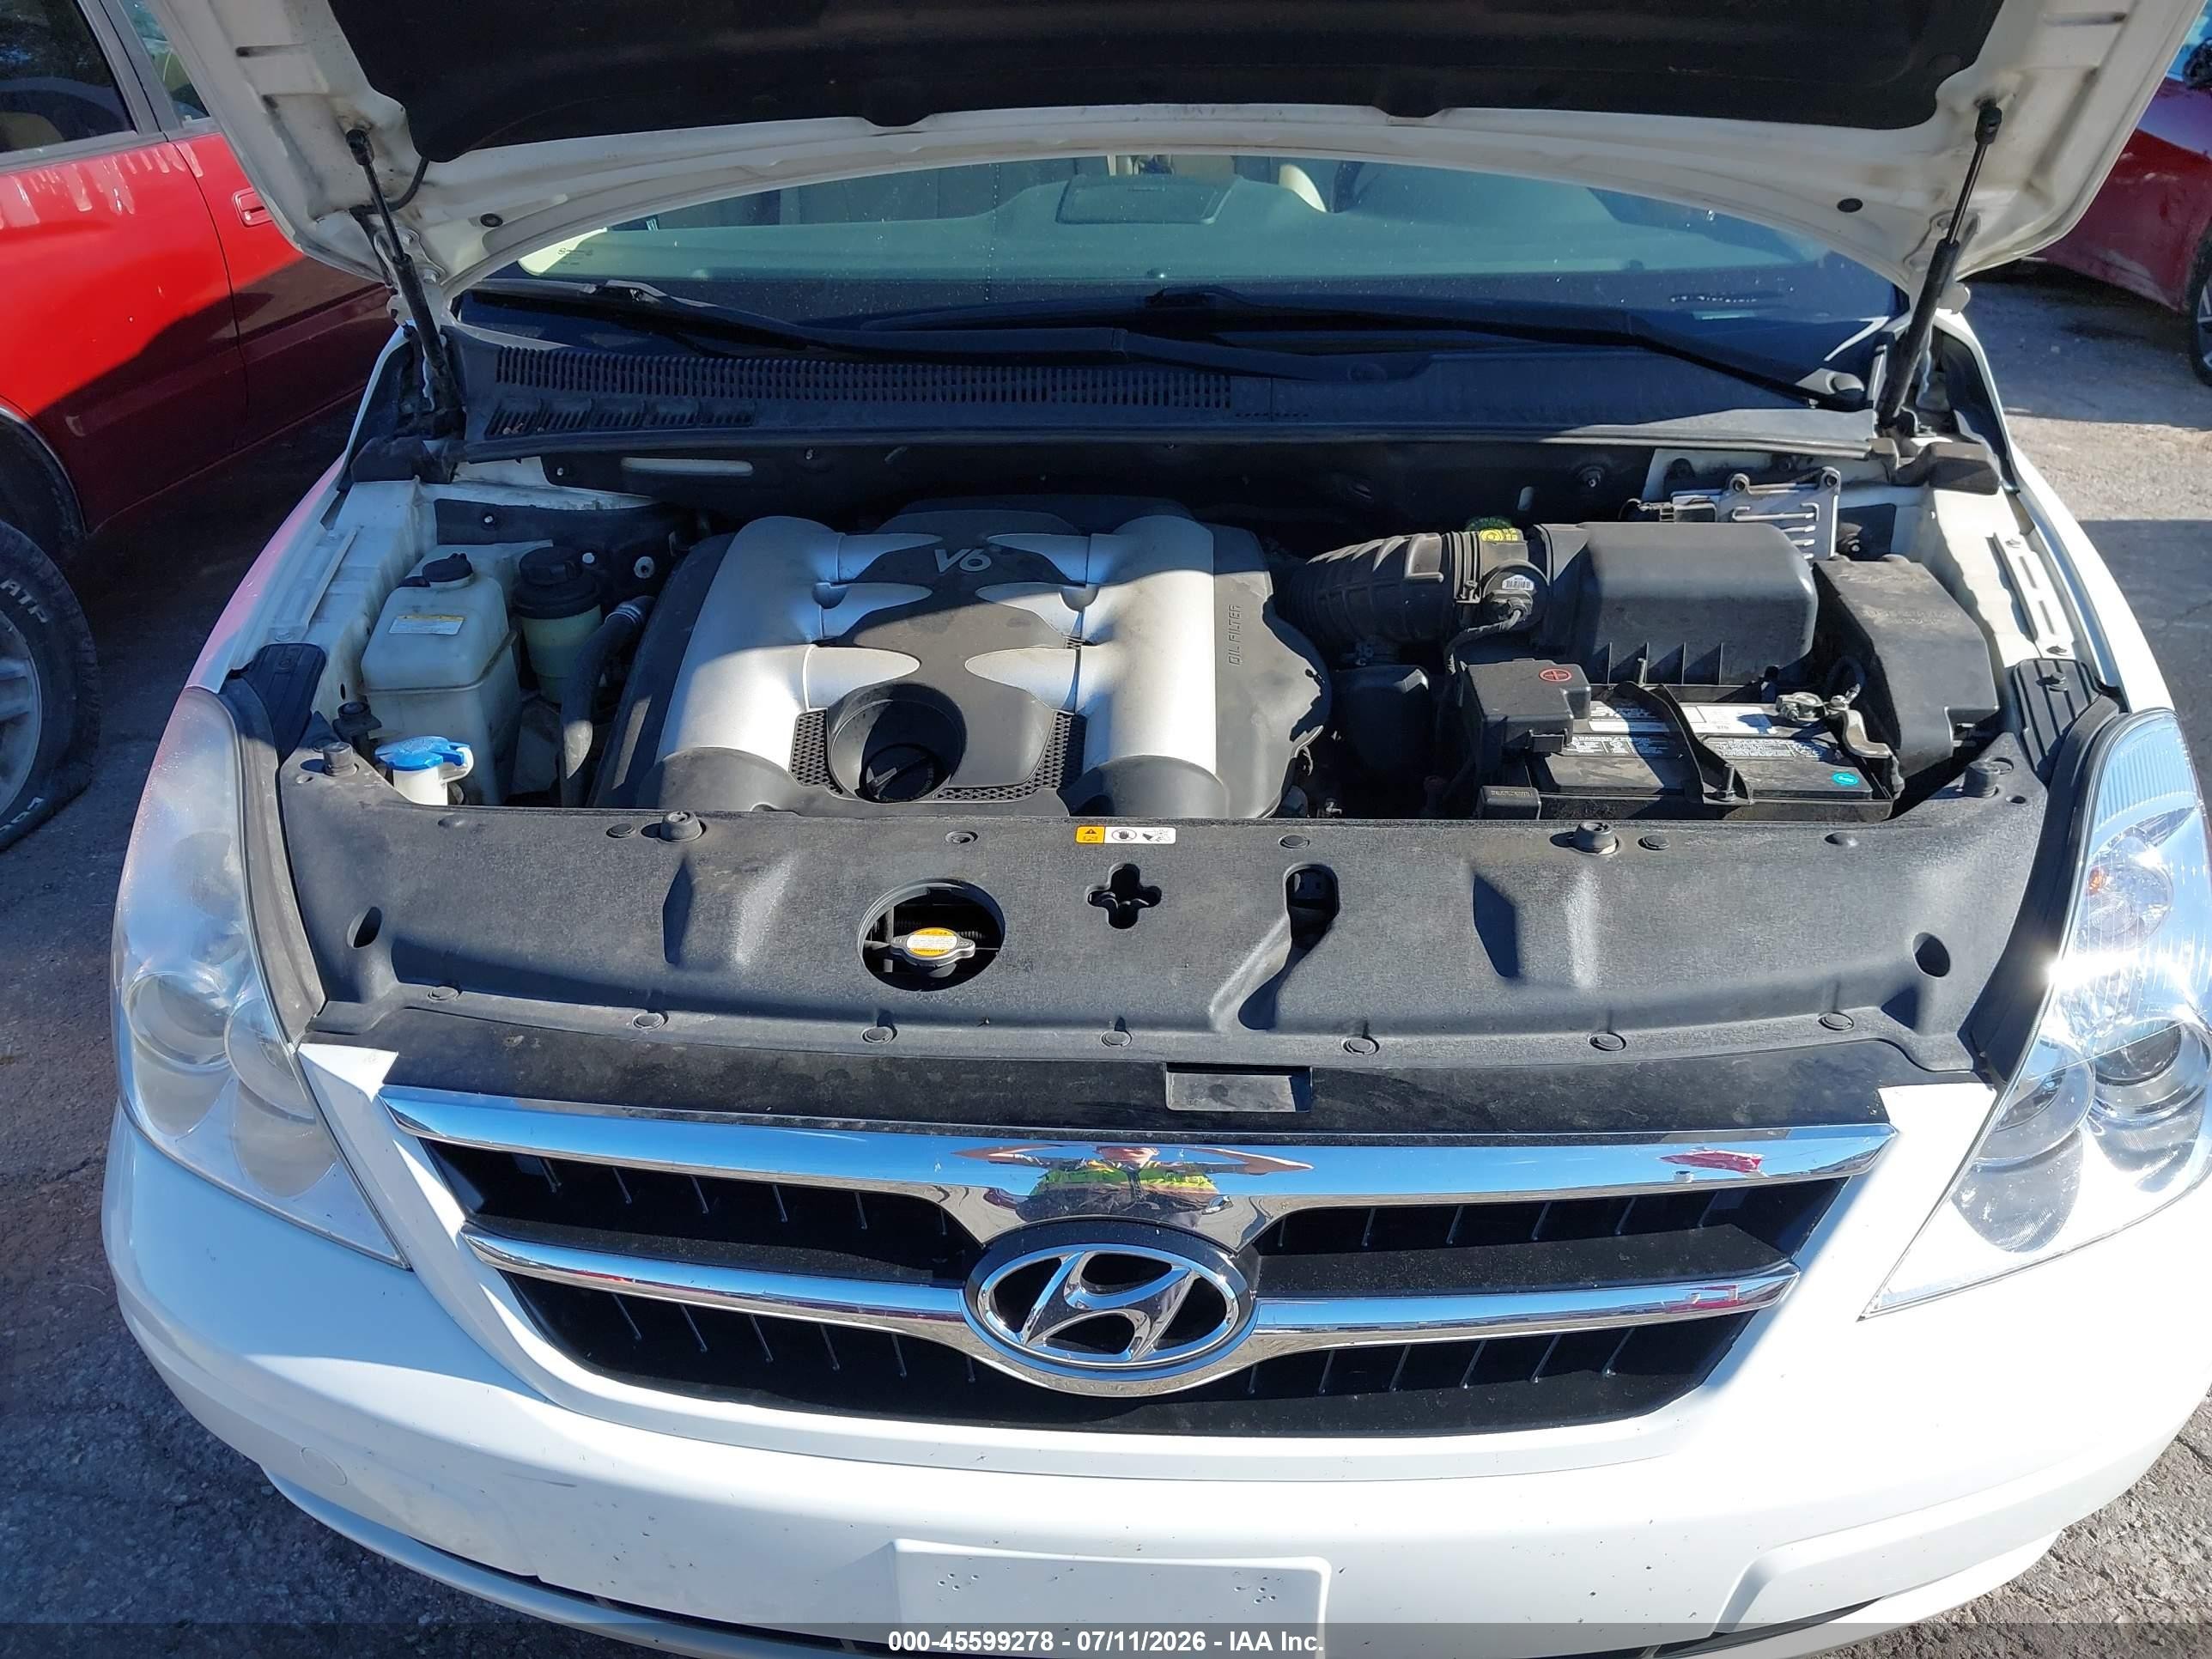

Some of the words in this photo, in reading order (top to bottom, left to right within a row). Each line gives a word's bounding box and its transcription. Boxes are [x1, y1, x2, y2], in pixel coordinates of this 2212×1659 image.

[934, 549, 992, 573] V6
[1227, 604, 1243, 643] FILTER
[1227, 646, 1242, 665] OIL
